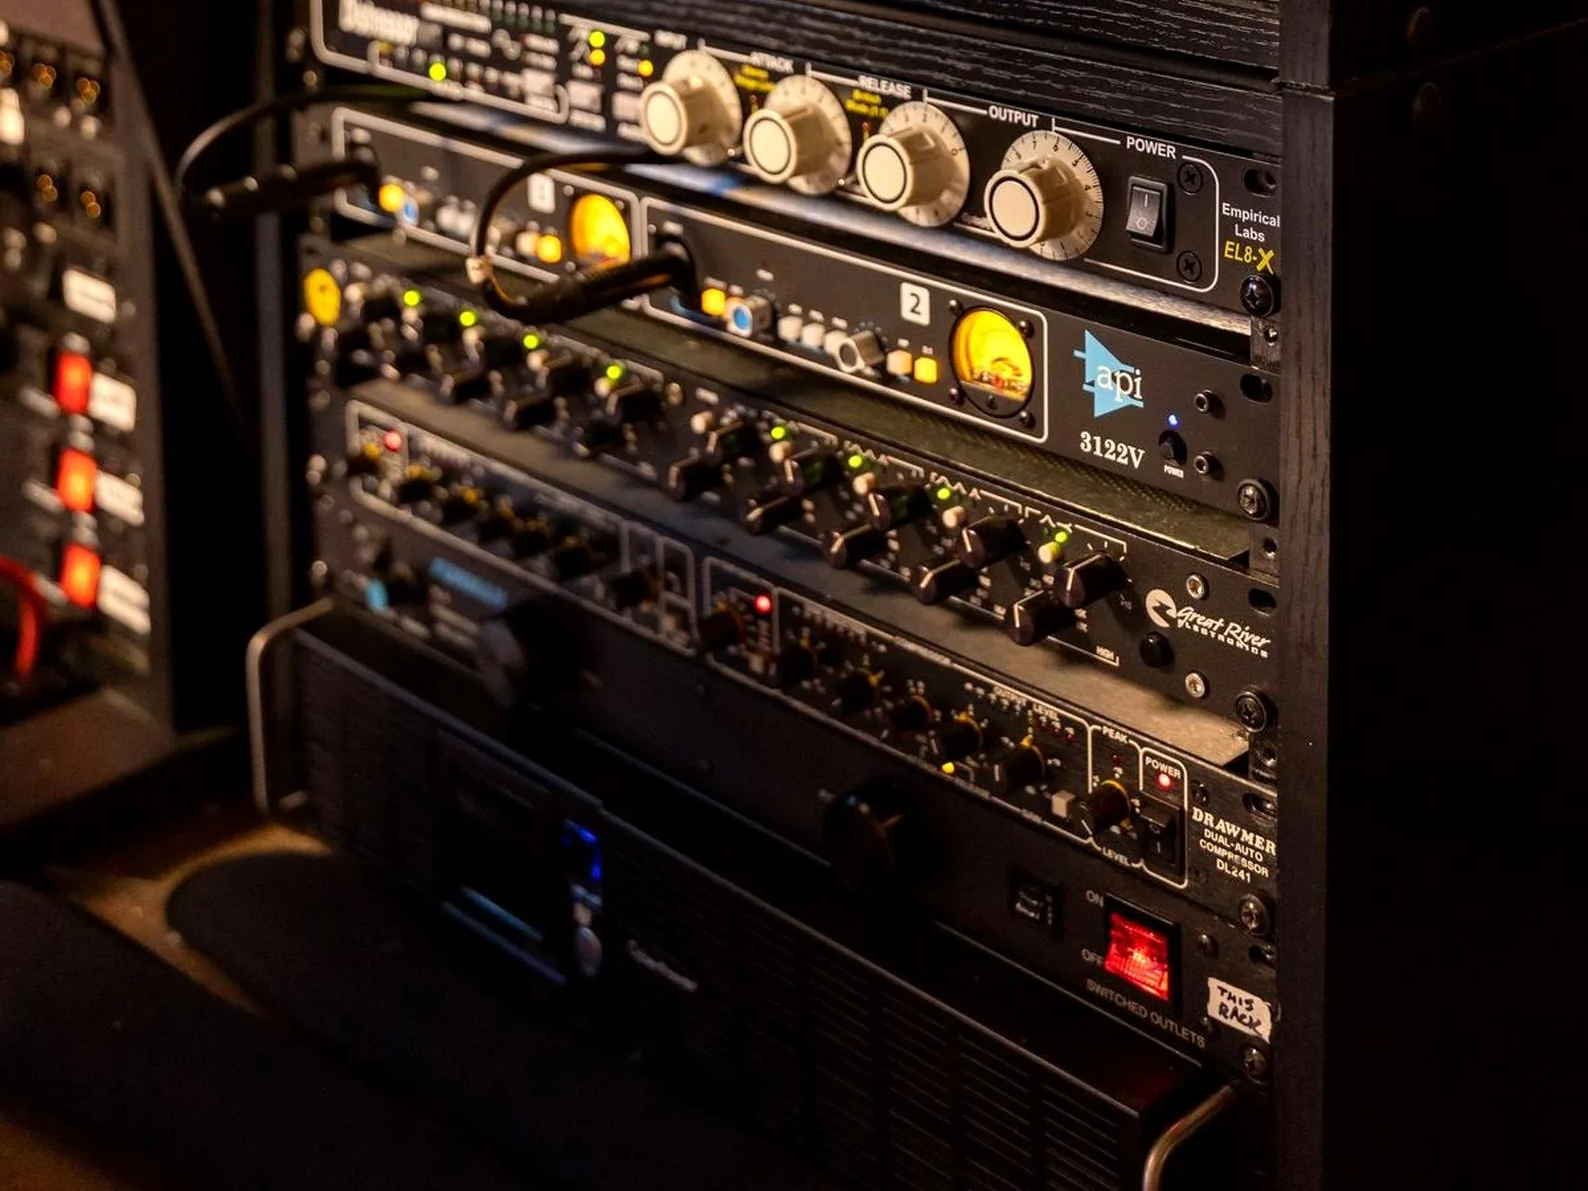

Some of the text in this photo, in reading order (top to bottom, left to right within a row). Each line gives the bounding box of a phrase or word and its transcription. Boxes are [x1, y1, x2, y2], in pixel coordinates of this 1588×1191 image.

[857, 75, 912, 100] RELEASE
[988, 105, 1039, 128] OUTPUT
[1126, 136, 1177, 159] POWER
[1221, 202, 1281, 228] Empirical
[1234, 224, 1266, 243] Labs
[1223, 241, 1275, 275] EL8-X
[909, 292, 922, 316] 2
[1096, 365, 1143, 402] api
[1080, 431, 1146, 470] 3122V
[1163, 464, 1185, 479] POWER
[1177, 606, 1272, 648] Great River
[1102, 725, 1129, 744] PEAK
[1145, 755, 1182, 779] POWER
[1191, 806, 1277, 856] DRAWMER
[1102, 847, 1130, 866] LEVEL
[1203, 828, 1263, 862] DUAL-AUTO
[1199, 838, 1269, 878] COMPRESSOR
[1216, 859, 1251, 884] DL241
[1086, 889, 1104, 907] ON
[1216, 985, 1255, 1012] THIS
[1086, 978, 1206, 1049] SWITCHED OUTLETS
[1218, 1004, 1263, 1031] RACK
